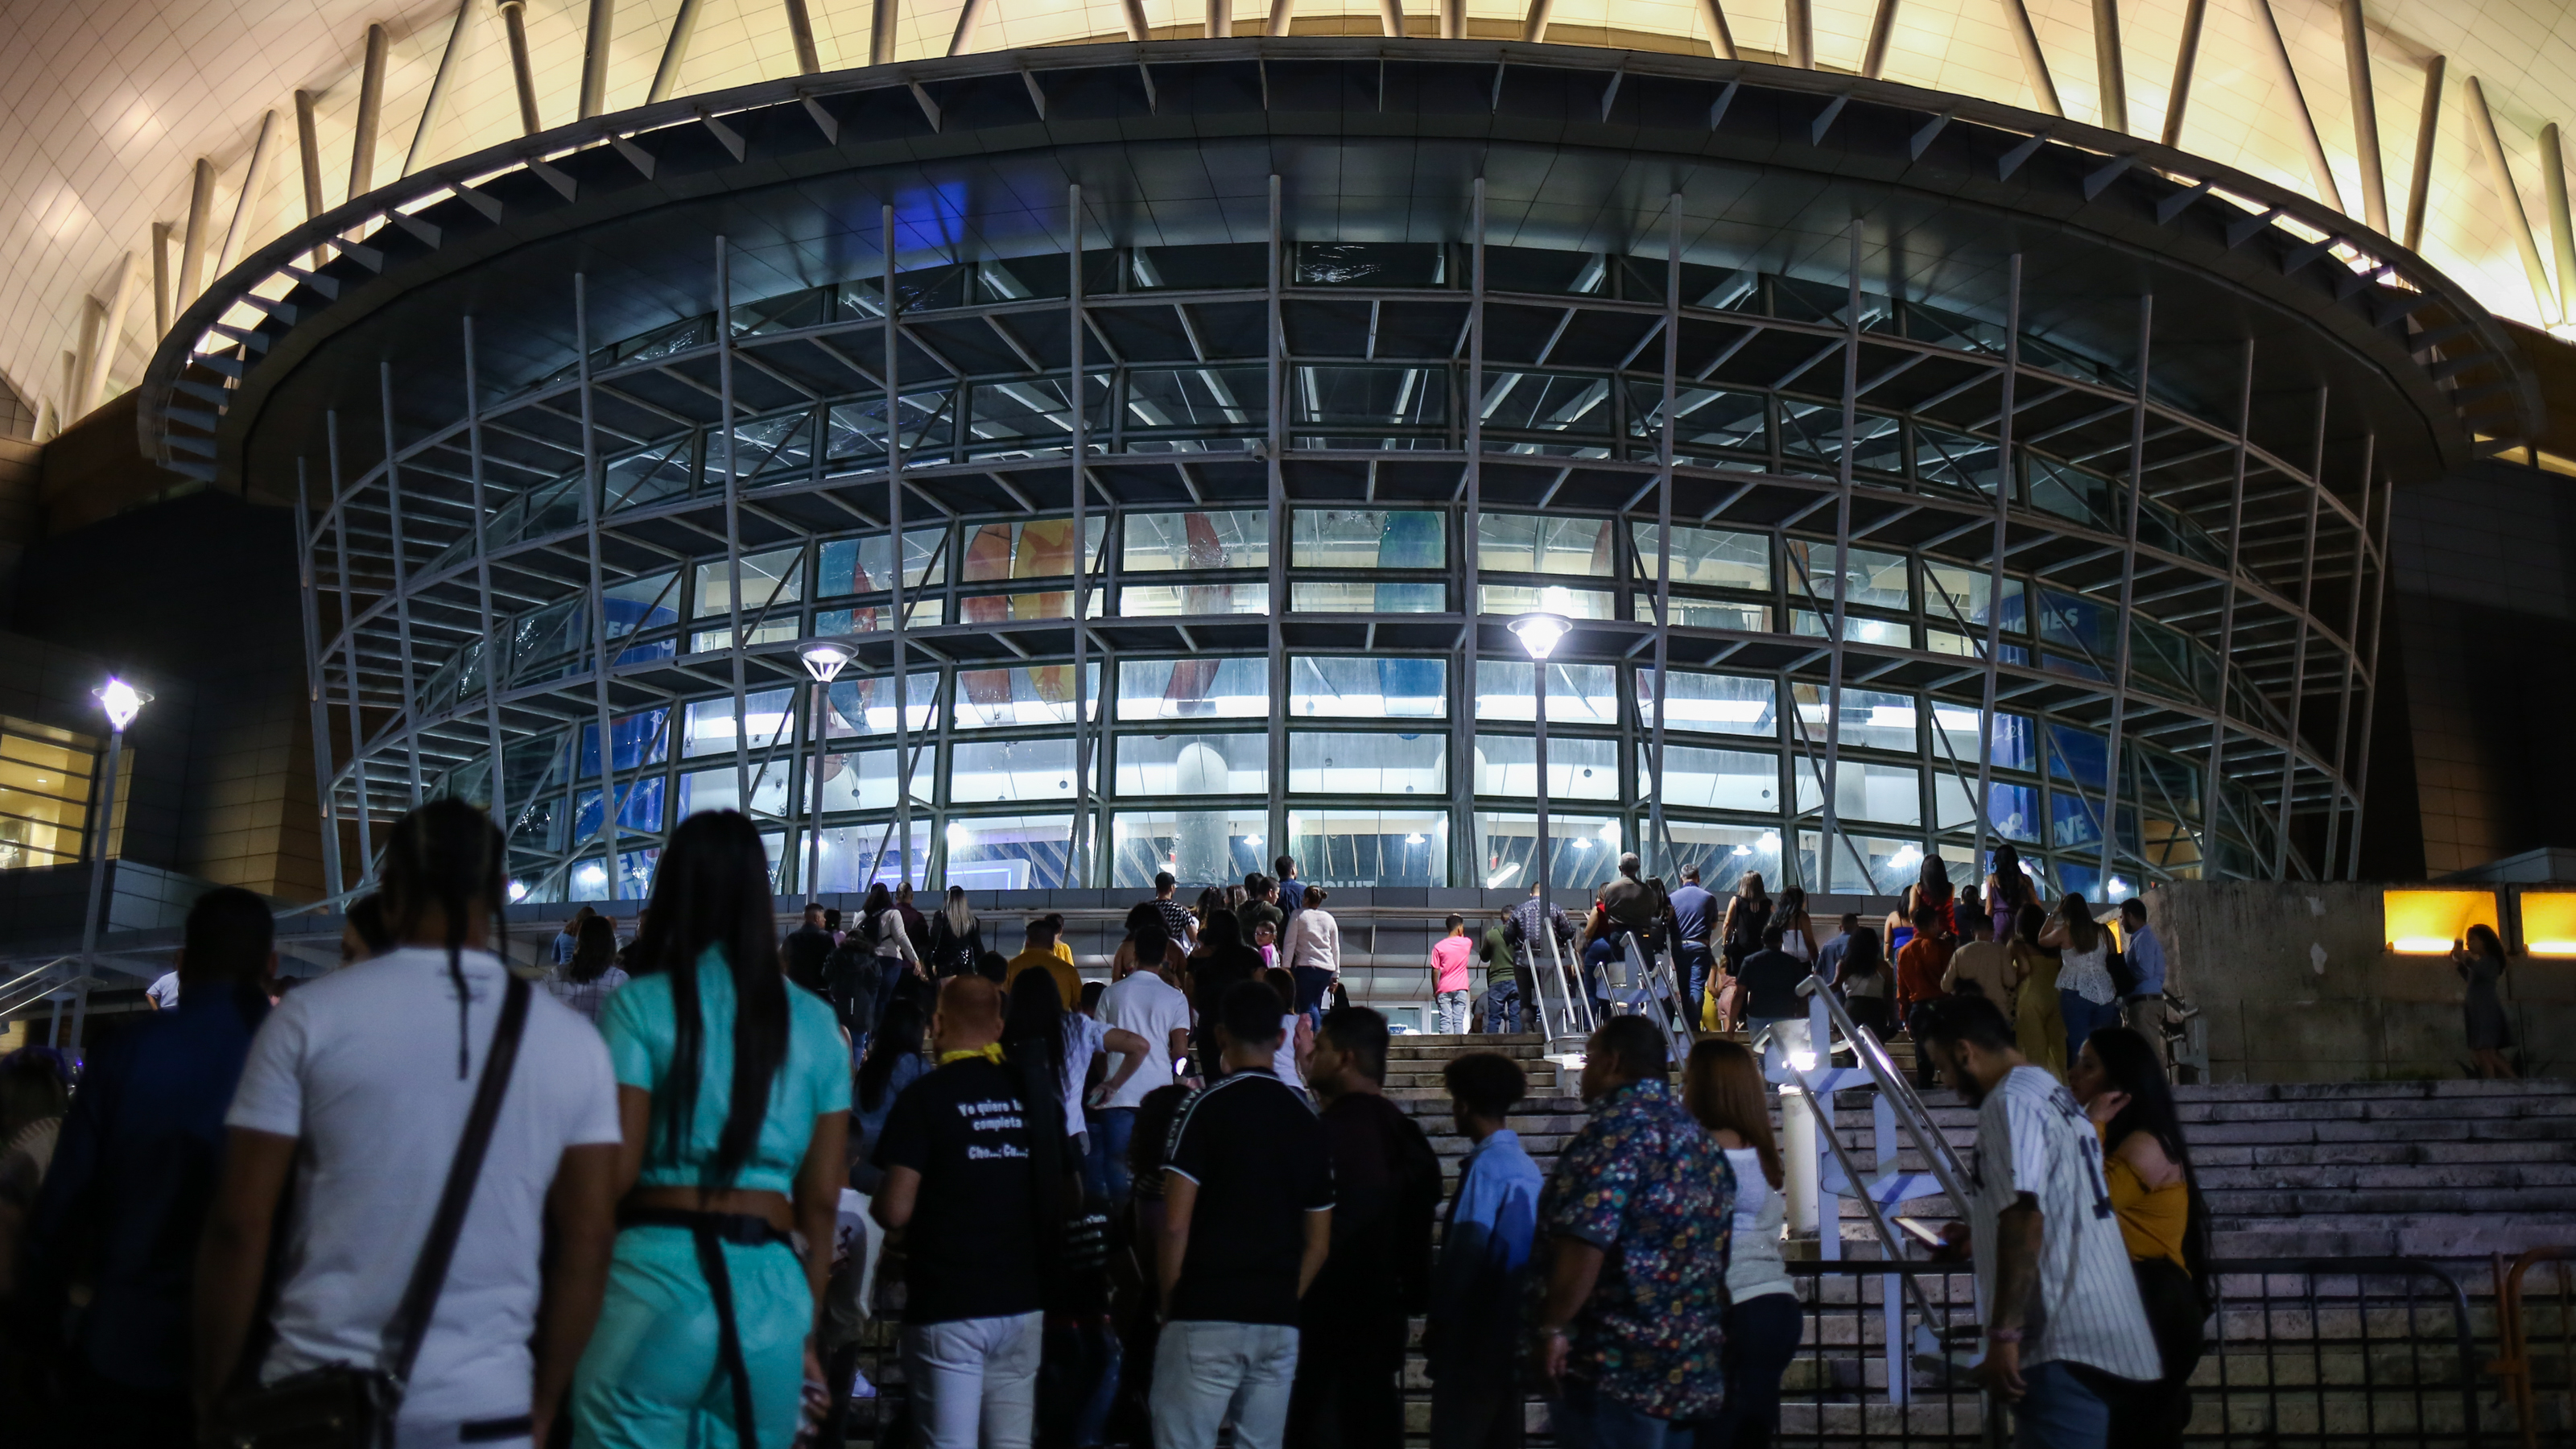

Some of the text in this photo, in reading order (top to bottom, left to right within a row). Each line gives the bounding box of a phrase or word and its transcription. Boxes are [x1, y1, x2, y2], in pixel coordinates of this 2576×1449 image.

[957, 1103, 976, 1117] Yo
[976, 1098, 1010, 1117] quiero
[972, 1116, 1023, 1132] completa
